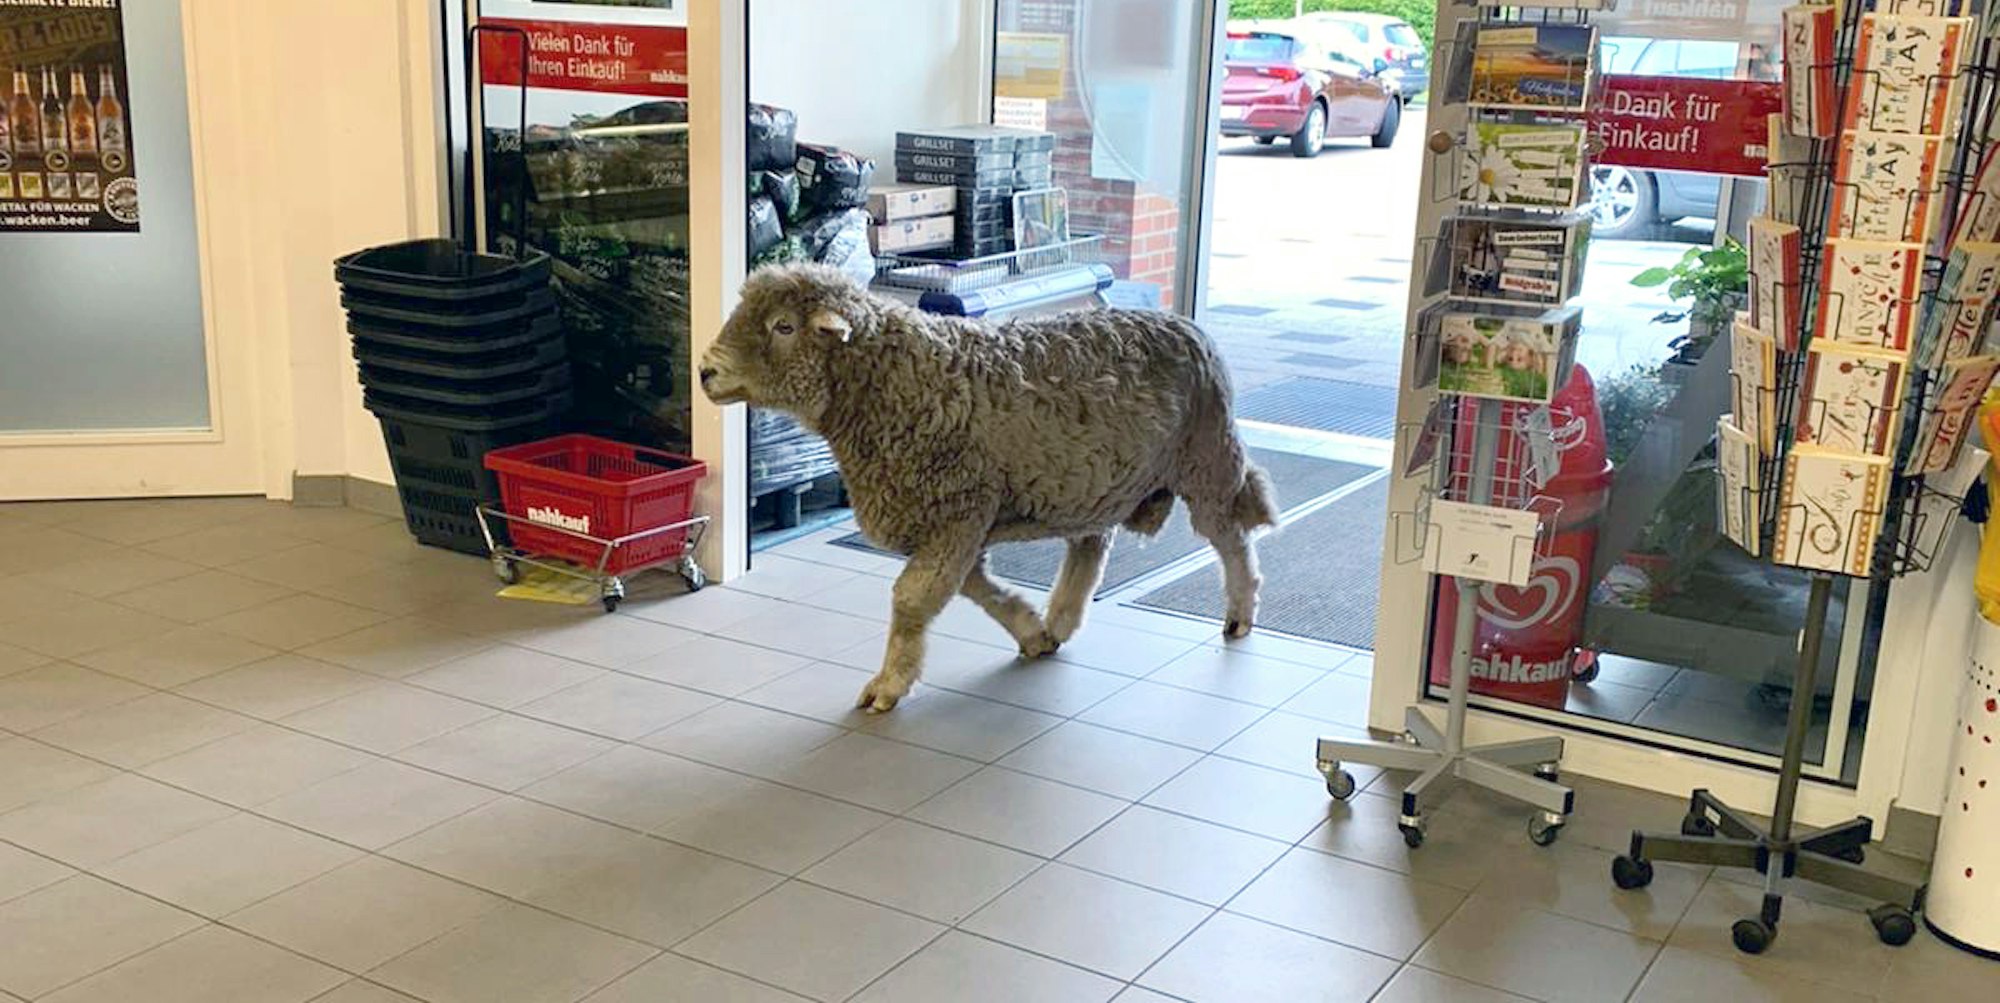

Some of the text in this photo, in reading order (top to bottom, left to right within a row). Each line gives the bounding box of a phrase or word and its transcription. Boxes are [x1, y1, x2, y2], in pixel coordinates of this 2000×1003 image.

[527, 31, 636, 56] Vielen Dank für
[528, 55, 627, 81] Ihren Einkauf!
[1614, 90, 1722, 122] Dank für
[912, 135, 956, 151] GRILLSET
[1599, 121, 1699, 154] Einkauf!
[912, 153, 956, 169] GRILLSET
[913, 170, 956, 185] GRILLSET
[0, 202, 29, 213] ETAL
[53, 202, 100, 213] WACKEN
[527, 506, 590, 534] nahkauf
[1471, 654, 1573, 685] ahkauf
